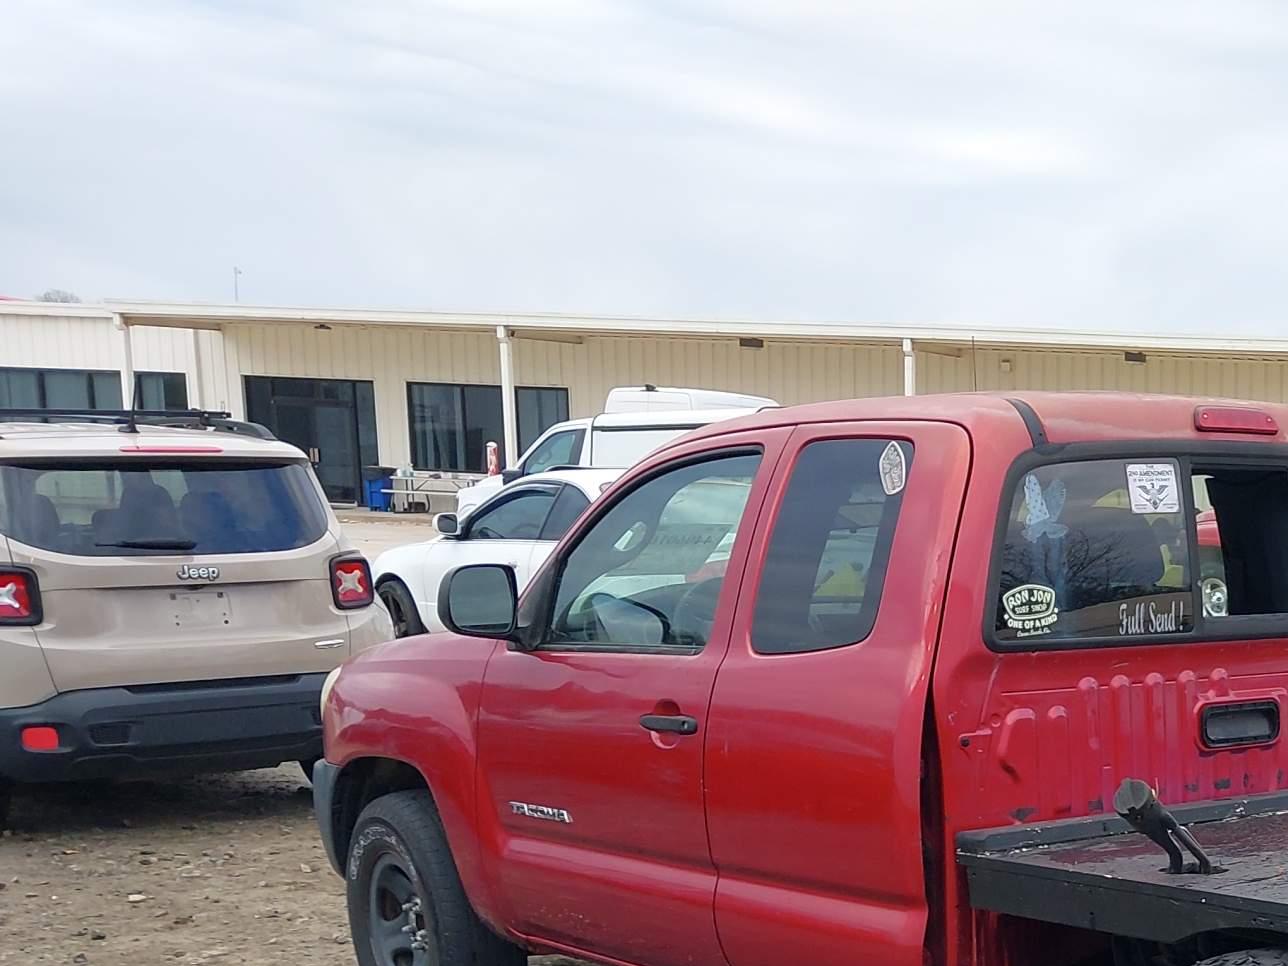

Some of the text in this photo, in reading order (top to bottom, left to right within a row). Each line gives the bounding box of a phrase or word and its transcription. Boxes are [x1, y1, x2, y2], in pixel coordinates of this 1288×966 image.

[176, 565, 219, 581] Jeep
[1008, 589, 1051, 609] RON JON
[1014, 603, 1047, 614] SURF SHOP
[1007, 613, 1058, 630] ONE OF A KIND
[1119, 603, 1145, 635] Full
[508, 801, 574, 823] TACOMA
